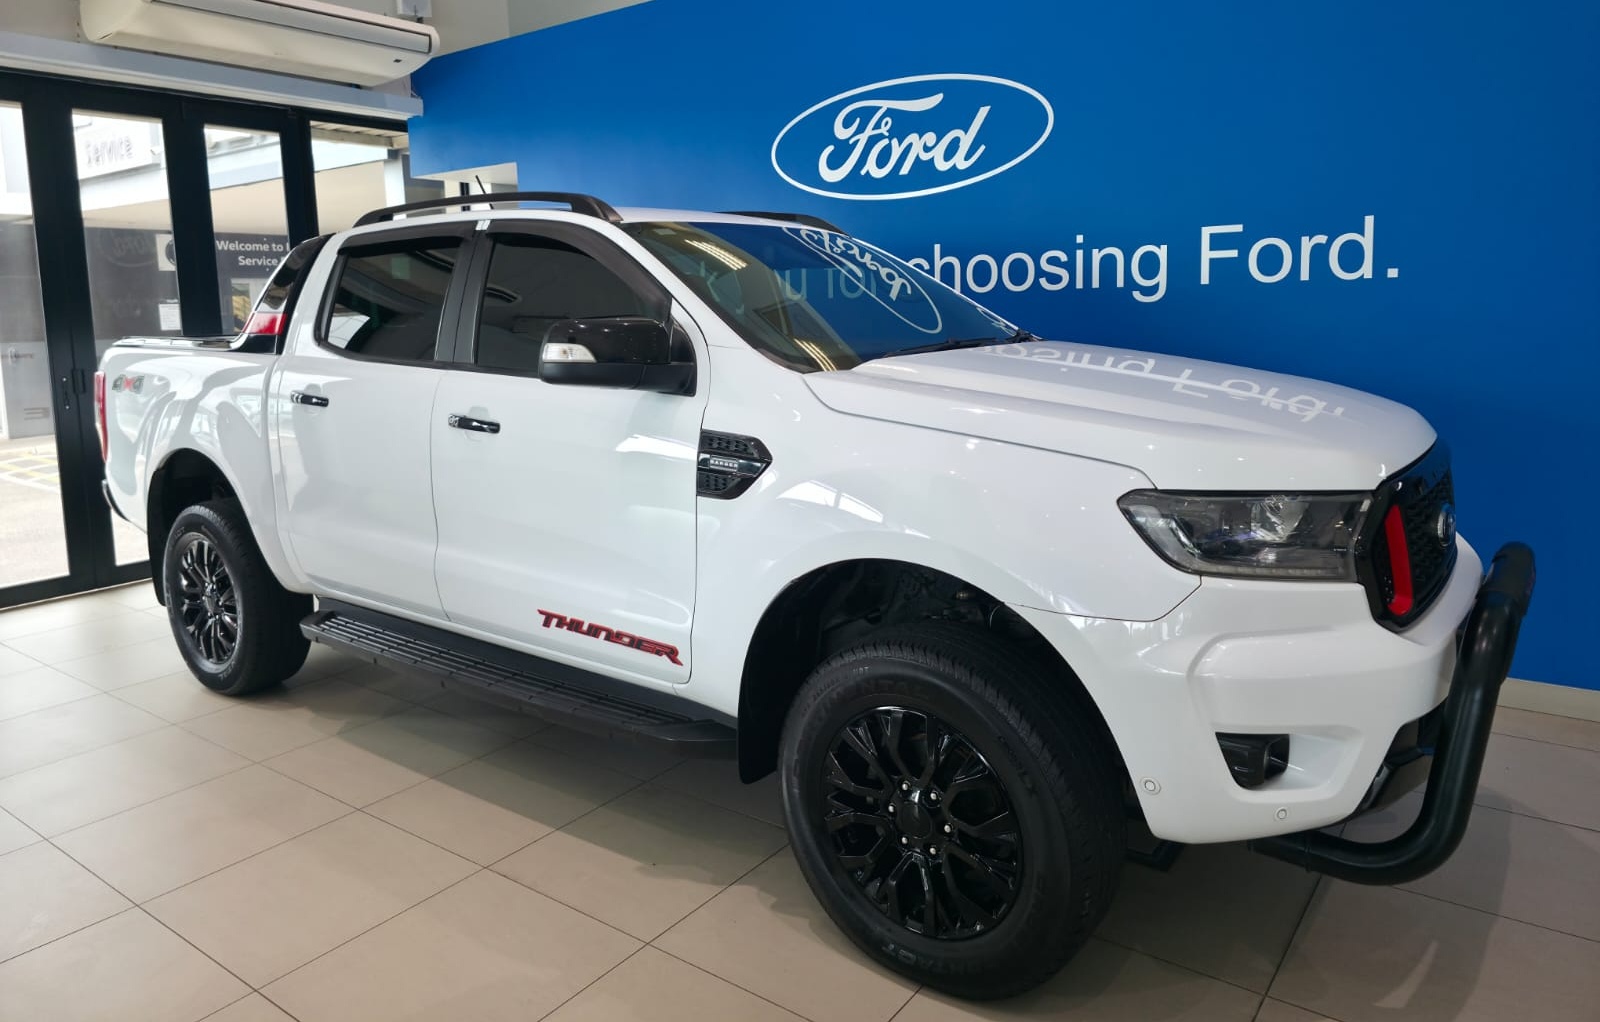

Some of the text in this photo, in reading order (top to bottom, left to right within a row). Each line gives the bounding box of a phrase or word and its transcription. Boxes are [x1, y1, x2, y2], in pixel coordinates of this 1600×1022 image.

[818, 93, 992, 182] Ford
[215, 240, 270, 252] Welcome
[272, 243, 284, 252] to
[238, 255, 278, 266] Service
[1200, 214, 1399, 285] Ford.
[537, 608, 684, 667] THUNDER
